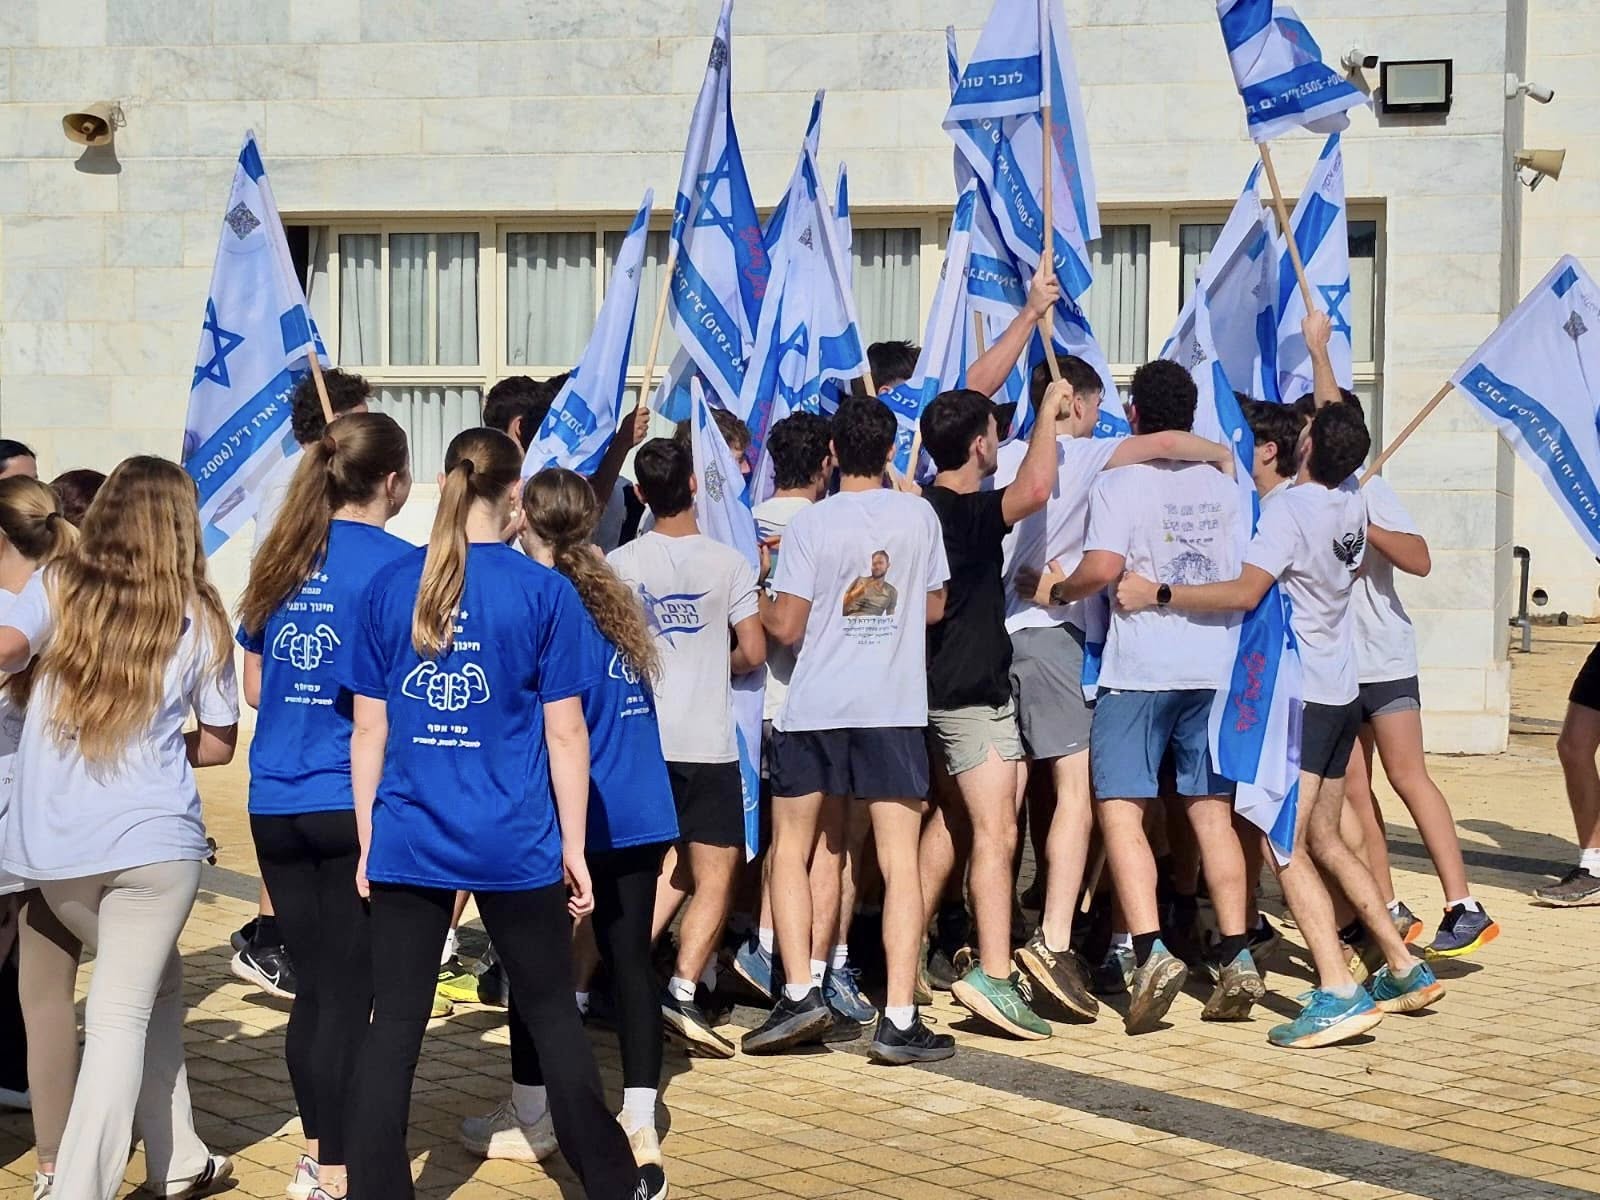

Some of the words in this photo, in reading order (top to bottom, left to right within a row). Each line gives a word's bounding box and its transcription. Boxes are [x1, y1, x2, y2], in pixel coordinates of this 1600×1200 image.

[988, 71, 1024, 86] לזכר
[251, 402, 280, 428] ארז
[661, 610, 699, 625] לזכרם
[1031, 941, 1057, 969] HOKA
